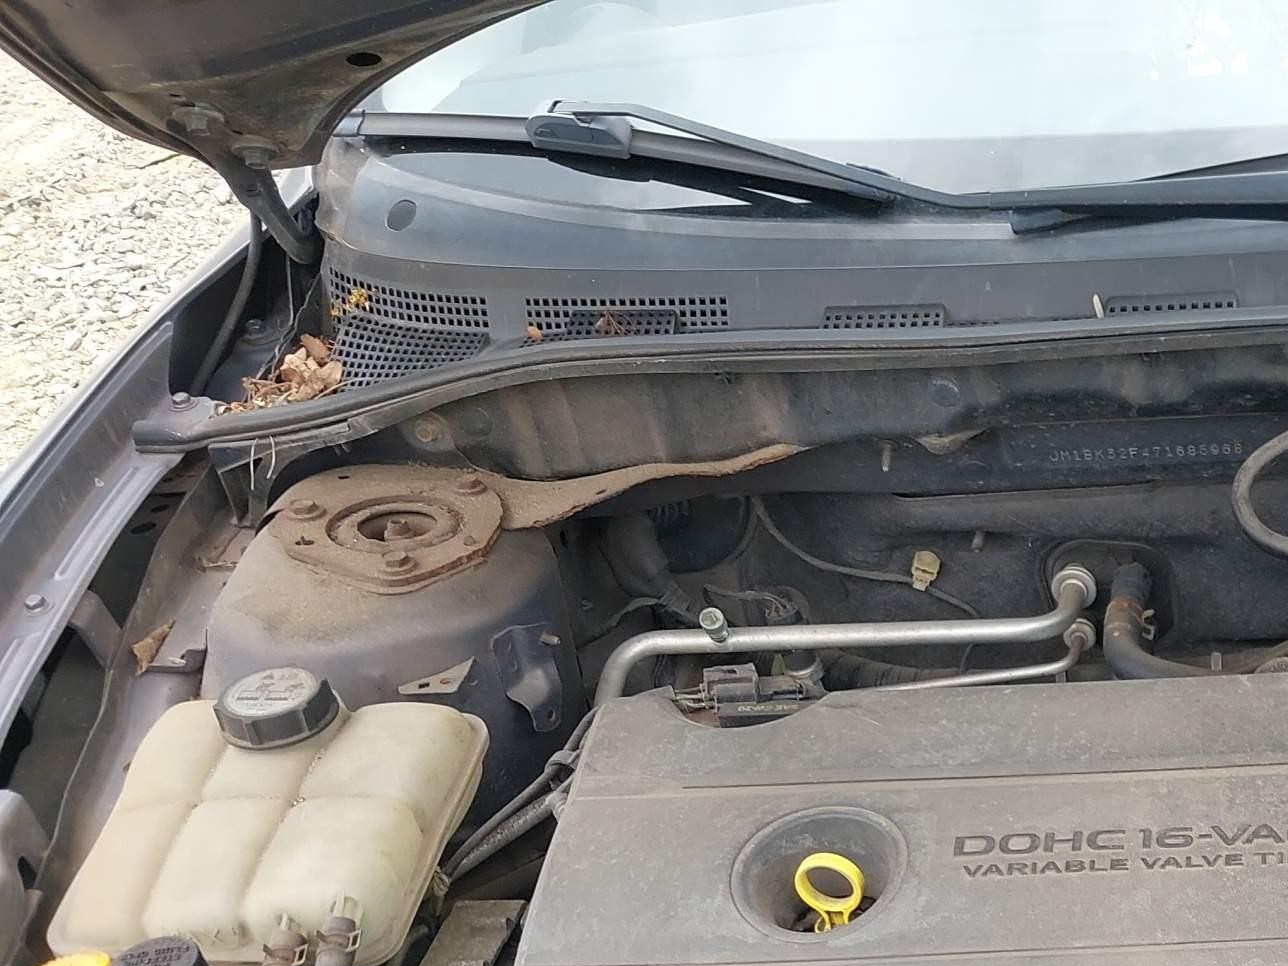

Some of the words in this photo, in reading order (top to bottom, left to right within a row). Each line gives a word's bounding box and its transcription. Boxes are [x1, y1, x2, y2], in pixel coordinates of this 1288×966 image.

[953, 829, 1127, 857] DOHC
[962, 857, 1130, 878] VARIABLE
[1140, 852, 1245, 870] VALVE
